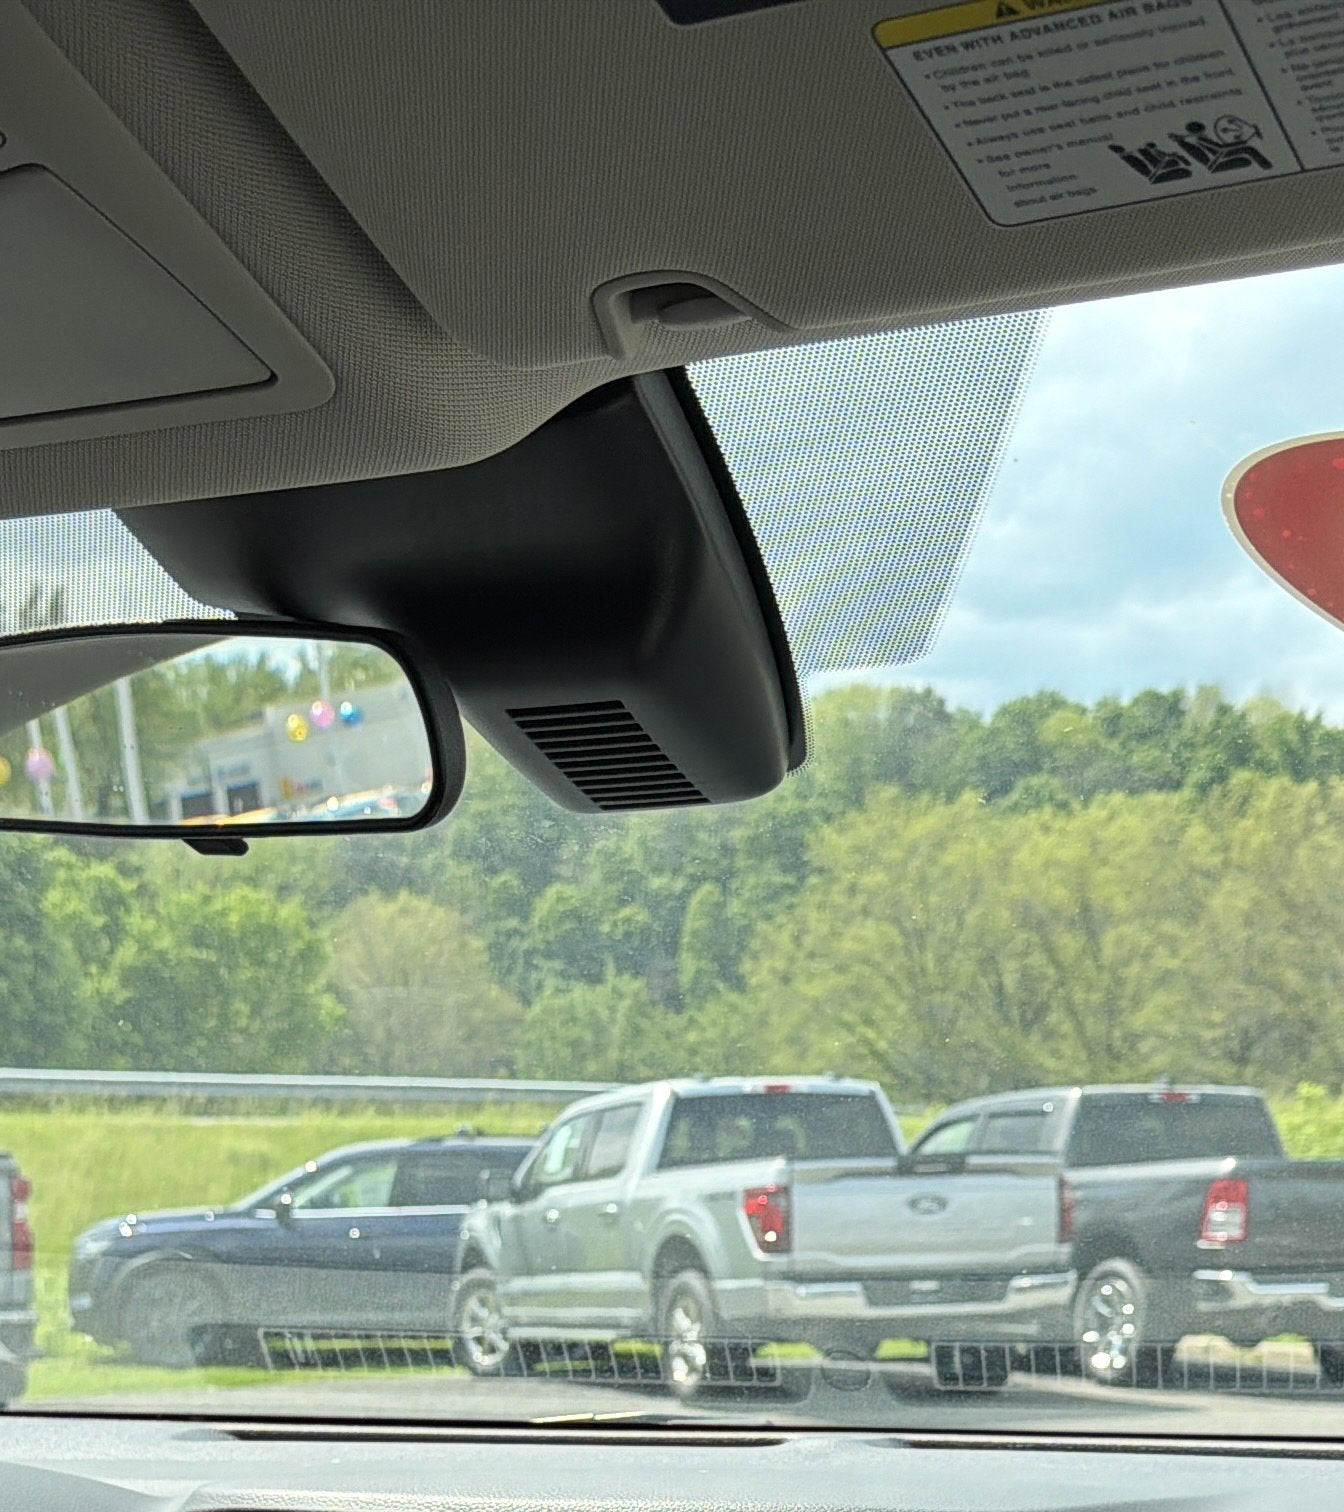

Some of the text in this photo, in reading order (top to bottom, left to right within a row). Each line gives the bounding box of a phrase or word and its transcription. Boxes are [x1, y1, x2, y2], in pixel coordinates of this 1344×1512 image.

[913, 42, 958, 60] EVEN
[959, 34, 1005, 54] WITH
[1009, 13, 1102, 42] ADVANCED
[1108, 6, 1139, 23] AIR
